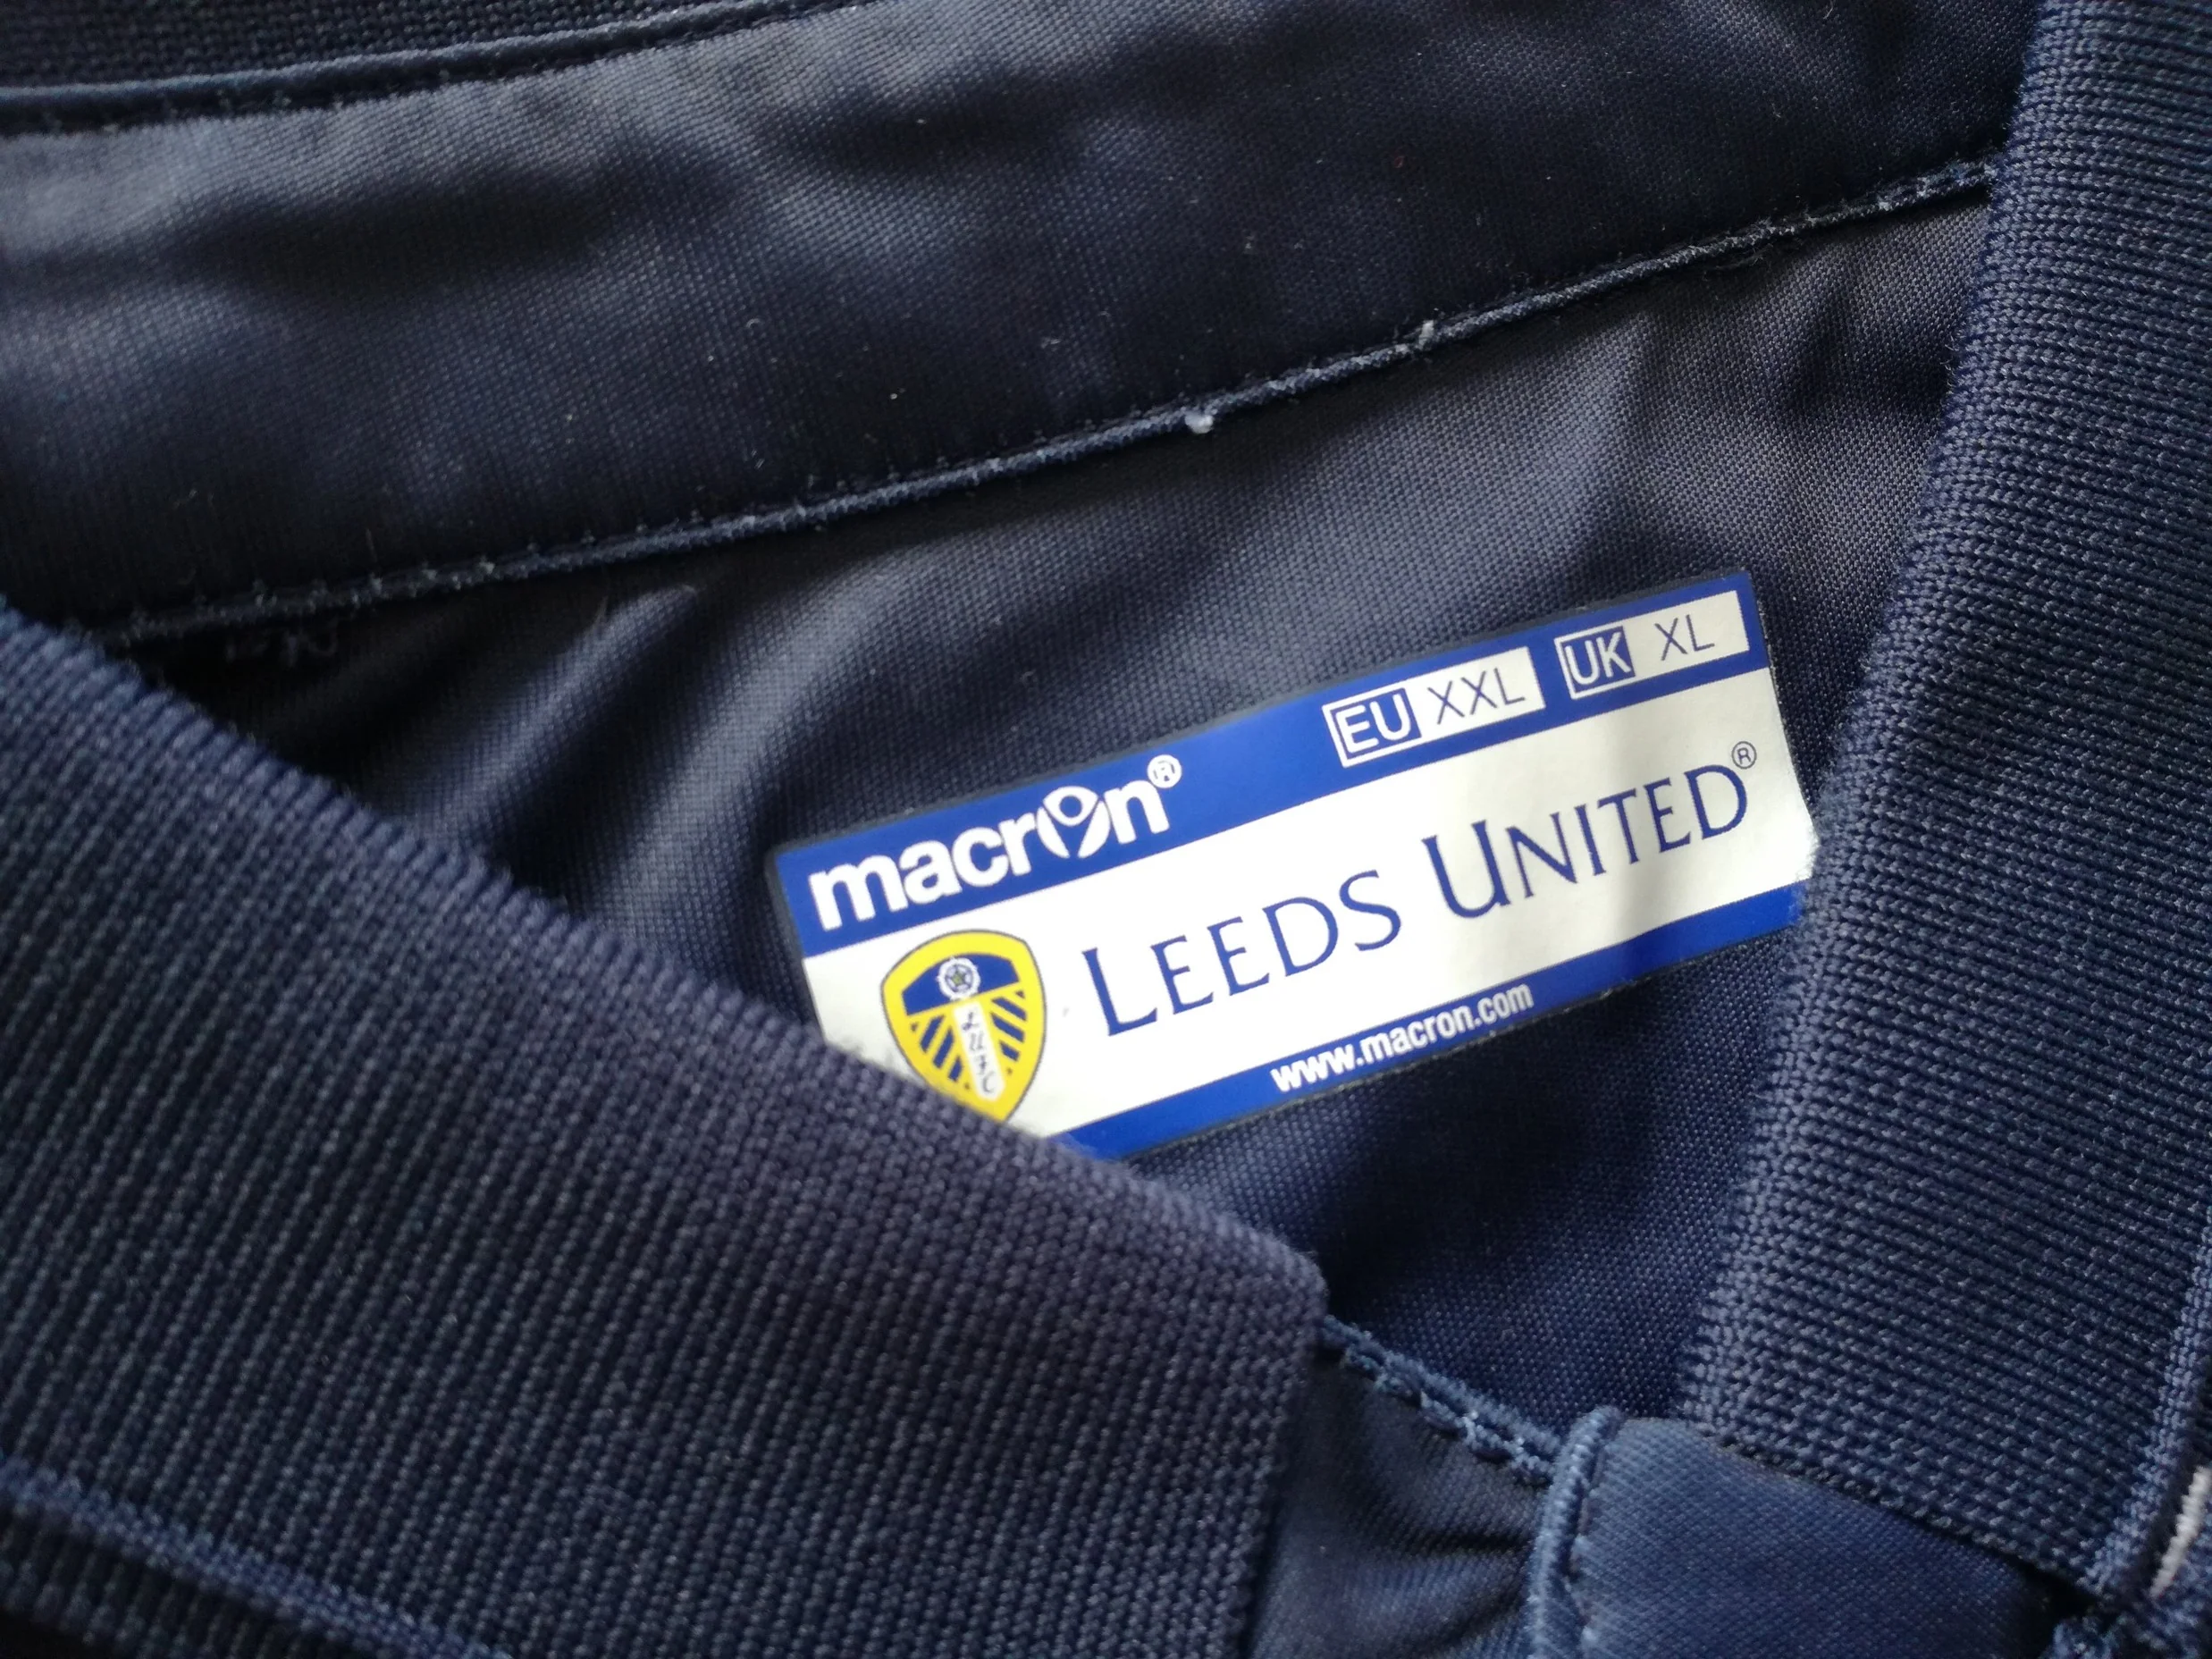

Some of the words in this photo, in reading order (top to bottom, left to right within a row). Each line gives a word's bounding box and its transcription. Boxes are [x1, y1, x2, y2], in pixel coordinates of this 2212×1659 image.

[1565, 629, 1632, 686] UK
[1654, 613, 1716, 662] XL
[1336, 692, 1413, 754] EU
[1427, 667, 1526, 726] XXL
[1081, 869, 1402, 1037] LEEDS
[1270, 983, 1535, 1092] www.macron.com
